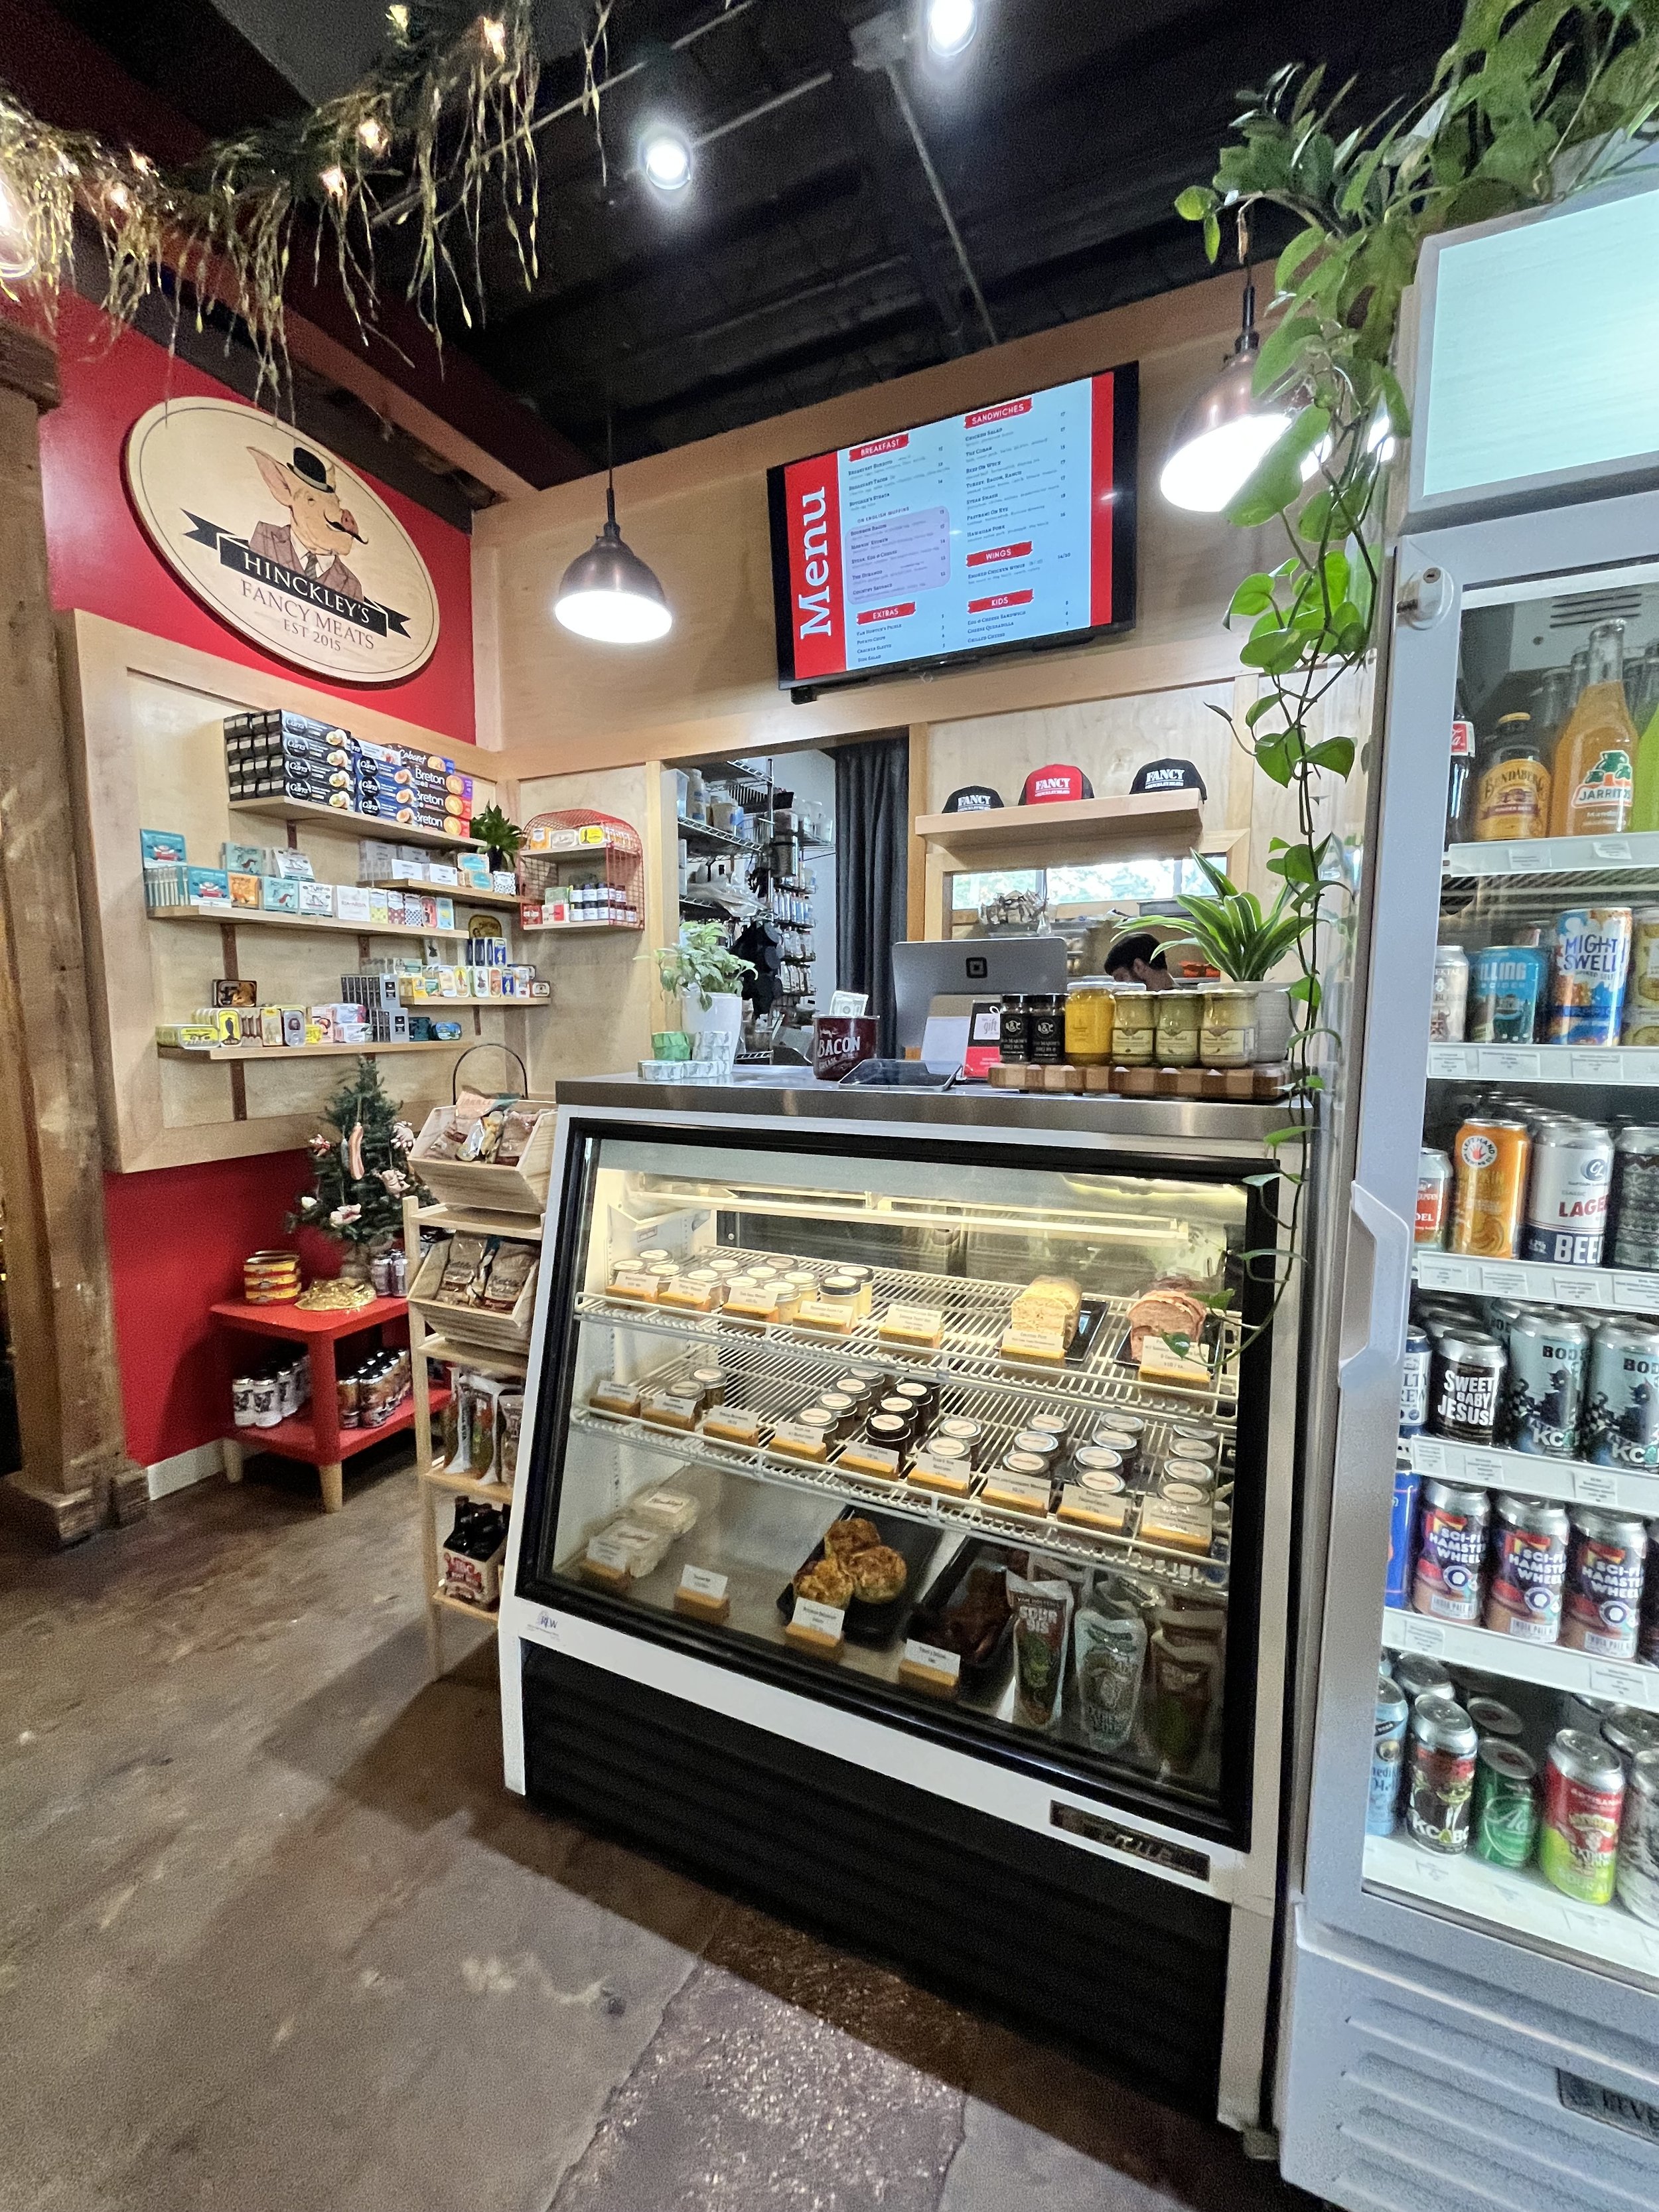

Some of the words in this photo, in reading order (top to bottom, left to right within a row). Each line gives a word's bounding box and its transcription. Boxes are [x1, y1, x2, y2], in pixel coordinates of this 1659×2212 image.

[972, 404, 1024, 425] SANDWICHES
[861, 439, 899, 456] BREAKFAST
[799, 486, 831, 639] Menu
[985, 548, 1011, 561] WINGS
[244, 552, 369, 623] HINCKLEY'S
[991, 597, 1009, 607] KIDS
[241, 579, 310, 622] FANCY
[315, 611, 374, 649] MEATS
[873, 608, 899, 619] EXTRAS
[284, 619, 308, 637] EST
[313, 631, 340, 651] 2015
[415, 768, 445, 785] Breton
[1035, 778, 1070, 791] FANCY
[1146, 769, 1185, 783] FANCY
[958, 794, 991, 806] FANCY
[1563, 954, 1617, 973] SWELL
[818, 1037, 860, 1058] BACON
[1559, 1194, 1607, 1217] LAGE
[1554, 1234, 1603, 1264] BEE
[1444, 1370, 1495, 1392] SWEET
[1437, 1394, 1493, 1426] JESUS!
[1457, 1392, 1490, 1410] BABY
[1441, 1528, 1480, 1543] SCI-FI
[1523, 1550, 1563, 1564] SCI-FI
[1597, 1562, 1640, 1577] SCI-FI
